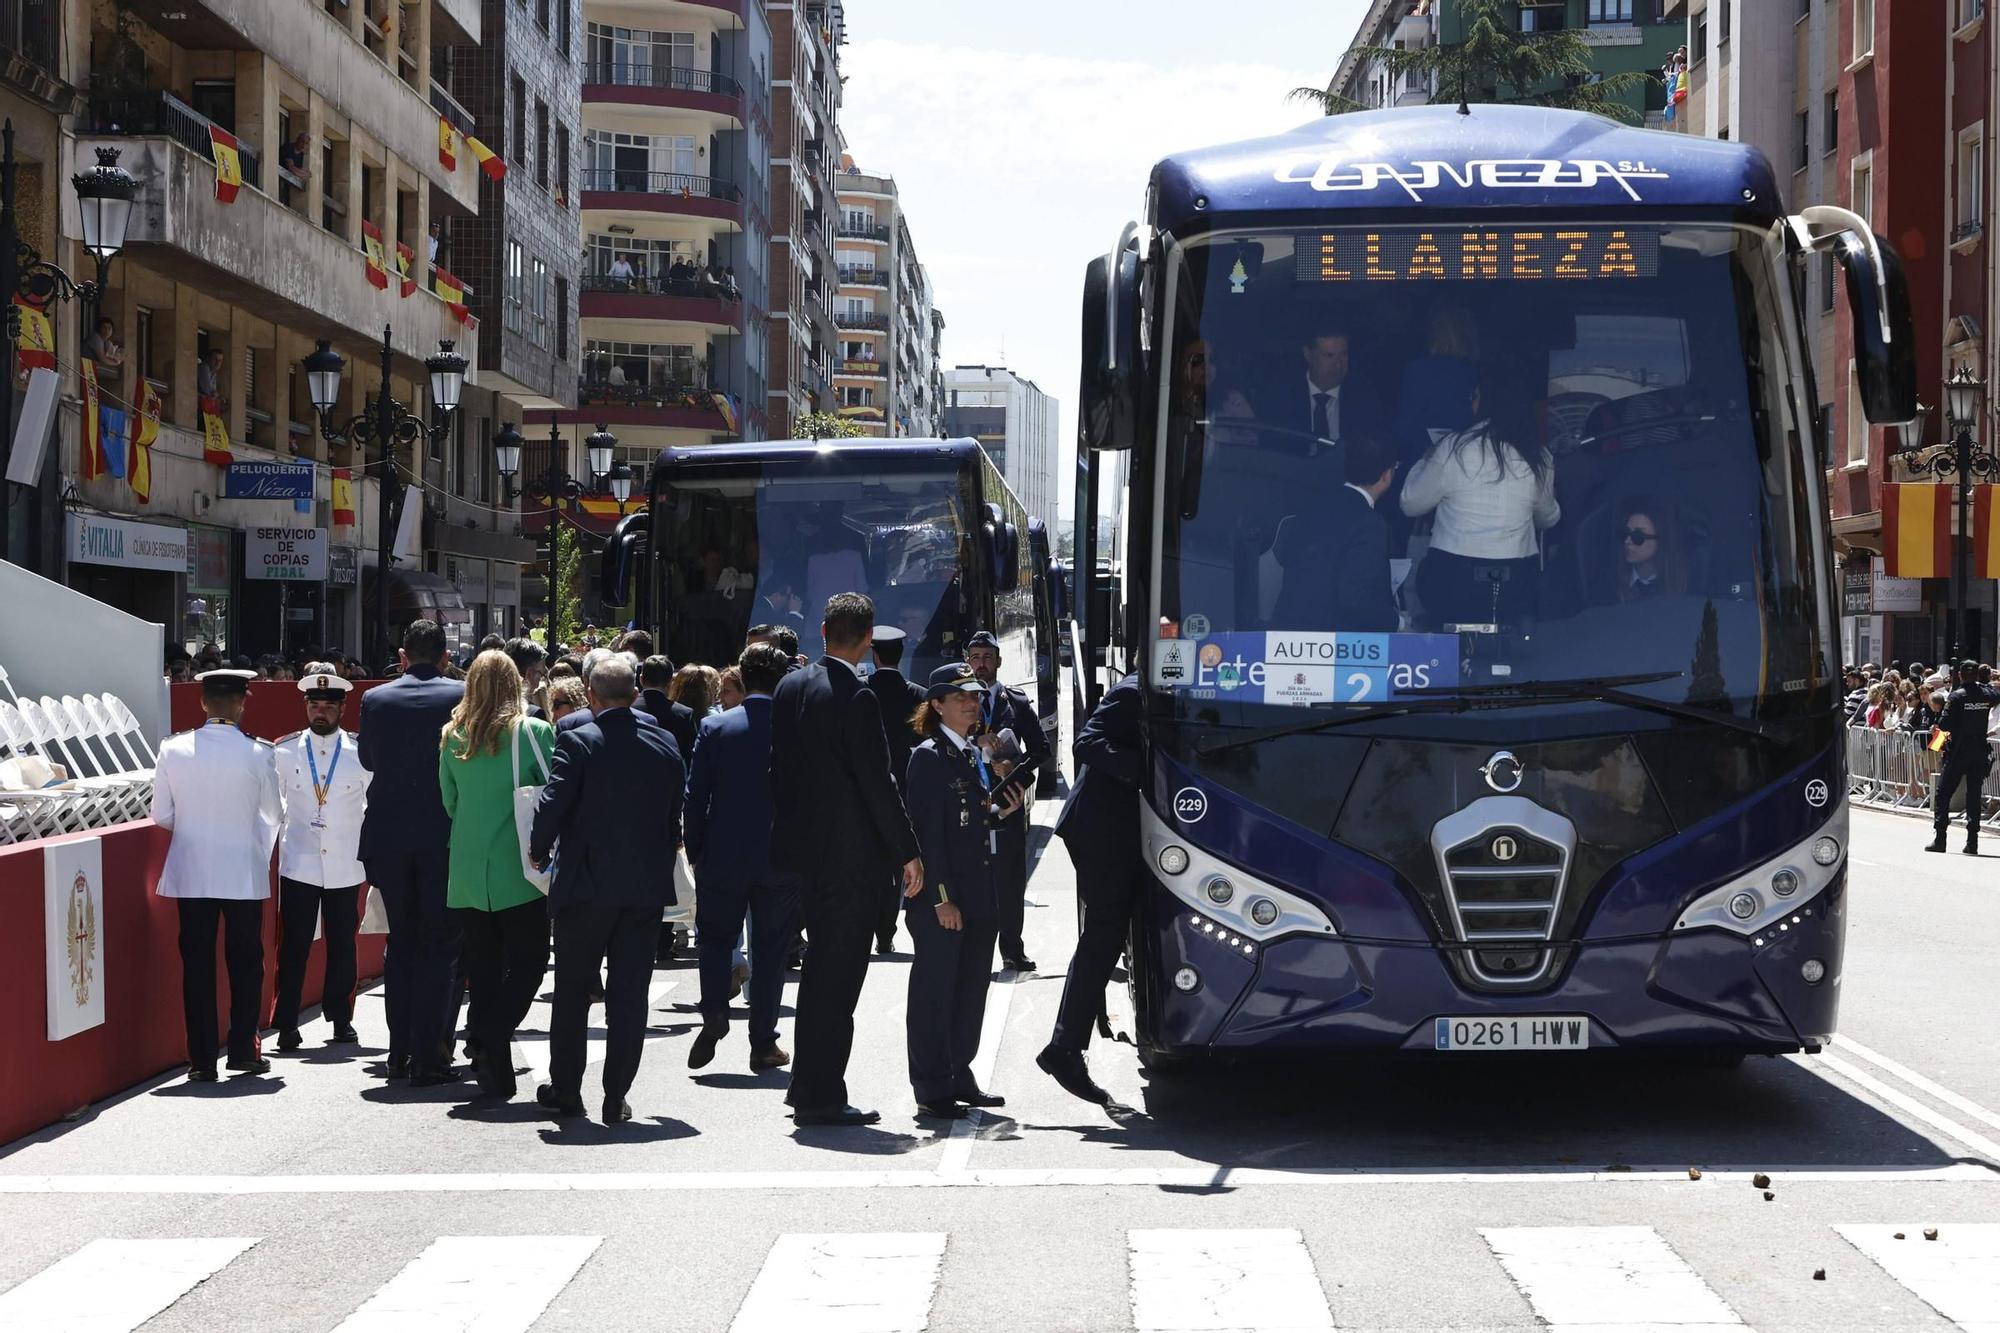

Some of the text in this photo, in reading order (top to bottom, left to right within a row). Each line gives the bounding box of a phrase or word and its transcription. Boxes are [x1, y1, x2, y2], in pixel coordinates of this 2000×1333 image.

[1618, 160, 1657, 173] S.L.
[1321, 231, 1639, 281] LLANEZA
[239, 477, 298, 497] Niza
[257, 528, 316, 540] SERVICIO
[88, 526, 124, 559] VITALIA
[278, 541, 295, 552] DE
[263, 554, 310, 565] COPIAS
[265, 566, 305, 578] PIDAL
[1273, 640, 1381, 660] AUTOBÚS
[1346, 672, 1373, 704] 2
[1808, 786, 1826, 800] 229
[1178, 798, 1203, 811] 229
[1440, 1021, 1581, 1046] E 0261 HWW
